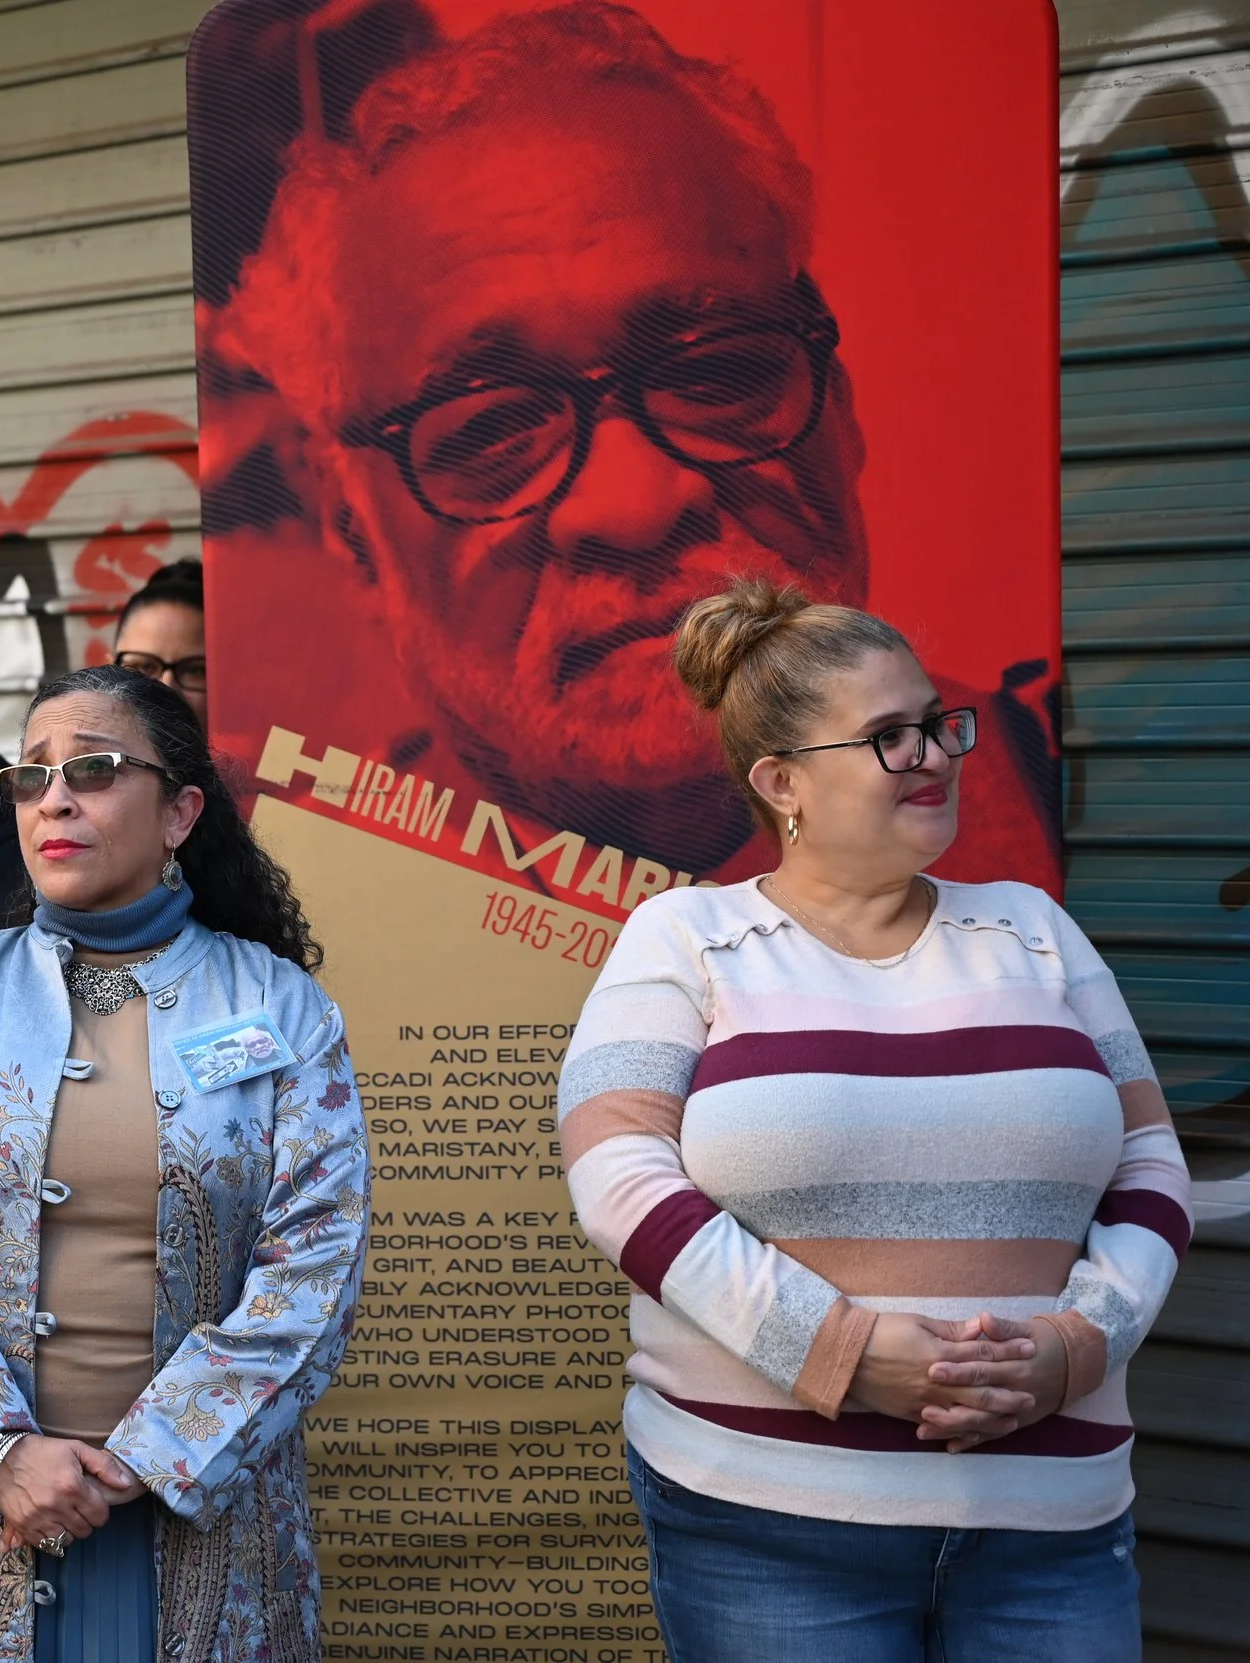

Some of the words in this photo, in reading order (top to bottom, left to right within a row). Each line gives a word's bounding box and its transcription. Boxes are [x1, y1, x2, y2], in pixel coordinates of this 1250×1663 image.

[255, 725, 455, 841] HIRAM
[460, 799, 722, 912] MAR
[480, 891, 618, 968] 1945-20
[399, 1025, 424, 1041] IN
[432, 1024, 490, 1041] OUR
[429, 1048, 488, 1064] AND
[496, 1047, 565, 1064] ELEV
[441, 1071, 560, 1088] ACKNOW
[361, 1095, 432, 1111] DERS
[441, 1095, 500, 1111] AND
[369, 1118, 413, 1137] SO,
[422, 1118, 468, 1134] WE
[476, 1118, 527, 1134] PAY
[378, 1141, 540, 1160] MARISTANY,
[402, 1211, 466, 1227] WAS
[475, 1211, 495, 1227] A
[504, 1211, 559, 1227] KEY
[370, 1234, 528, 1251] BORHOOD'S
[372, 1257, 436, 1276] GRIT,
[445, 1258, 503, 1274] AND
[511, 1258, 619, 1274] BEAUTY
[361, 1280, 408, 1297] BLY
[418, 1280, 631, 1297] ACKNOWLEDGE
[350, 1326, 414, 1343] WHO
[422, 1327, 610, 1344] UNDERSTOOD
[428, 1350, 557, 1367] ERASURE
[565, 1350, 625, 1367] AND
[388, 1373, 456, 1389] OWN
[464, 1373, 545, 1390] VOICE
[553, 1374, 613, 1390] AND
[305, 1416, 349, 1433] WE
[357, 1418, 430, 1435] HOPE
[438, 1419, 501, 1436] THIS
[509, 1420, 623, 1436] DISPLAY
[321, 1440, 387, 1457] WILL
[394, 1442, 499, 1458] INSPIRE
[507, 1442, 565, 1458] YOU
[573, 1442, 611, 1459] TO
[462, 1464, 499, 1481] TO
[508, 1465, 629, 1482] APPRECI
[348, 1484, 513, 1503] COLLECTIVE
[521, 1488, 580, 1505] AND
[338, 1508, 392, 1525] THE
[400, 1509, 587, 1531] CHALLENGES,
[595, 1510, 644, 1527] ING
[312, 1530, 468, 1550] STRATEGIES
[476, 1533, 531, 1549] FOR
[319, 1575, 441, 1592] EXPLORE
[449, 1577, 517, 1594] HOW
[526, 1578, 584, 1595] YOU
[592, 1579, 649, 1596] TOO
[338, 1598, 578, 1618] NEIGHBORHOOD'S
[438, 1623, 497, 1640] AND
[505, 1624, 663, 1642] EXPRESSIO
[433, 1645, 588, 1663] NARRATION
[597, 1648, 632, 1663] OF
